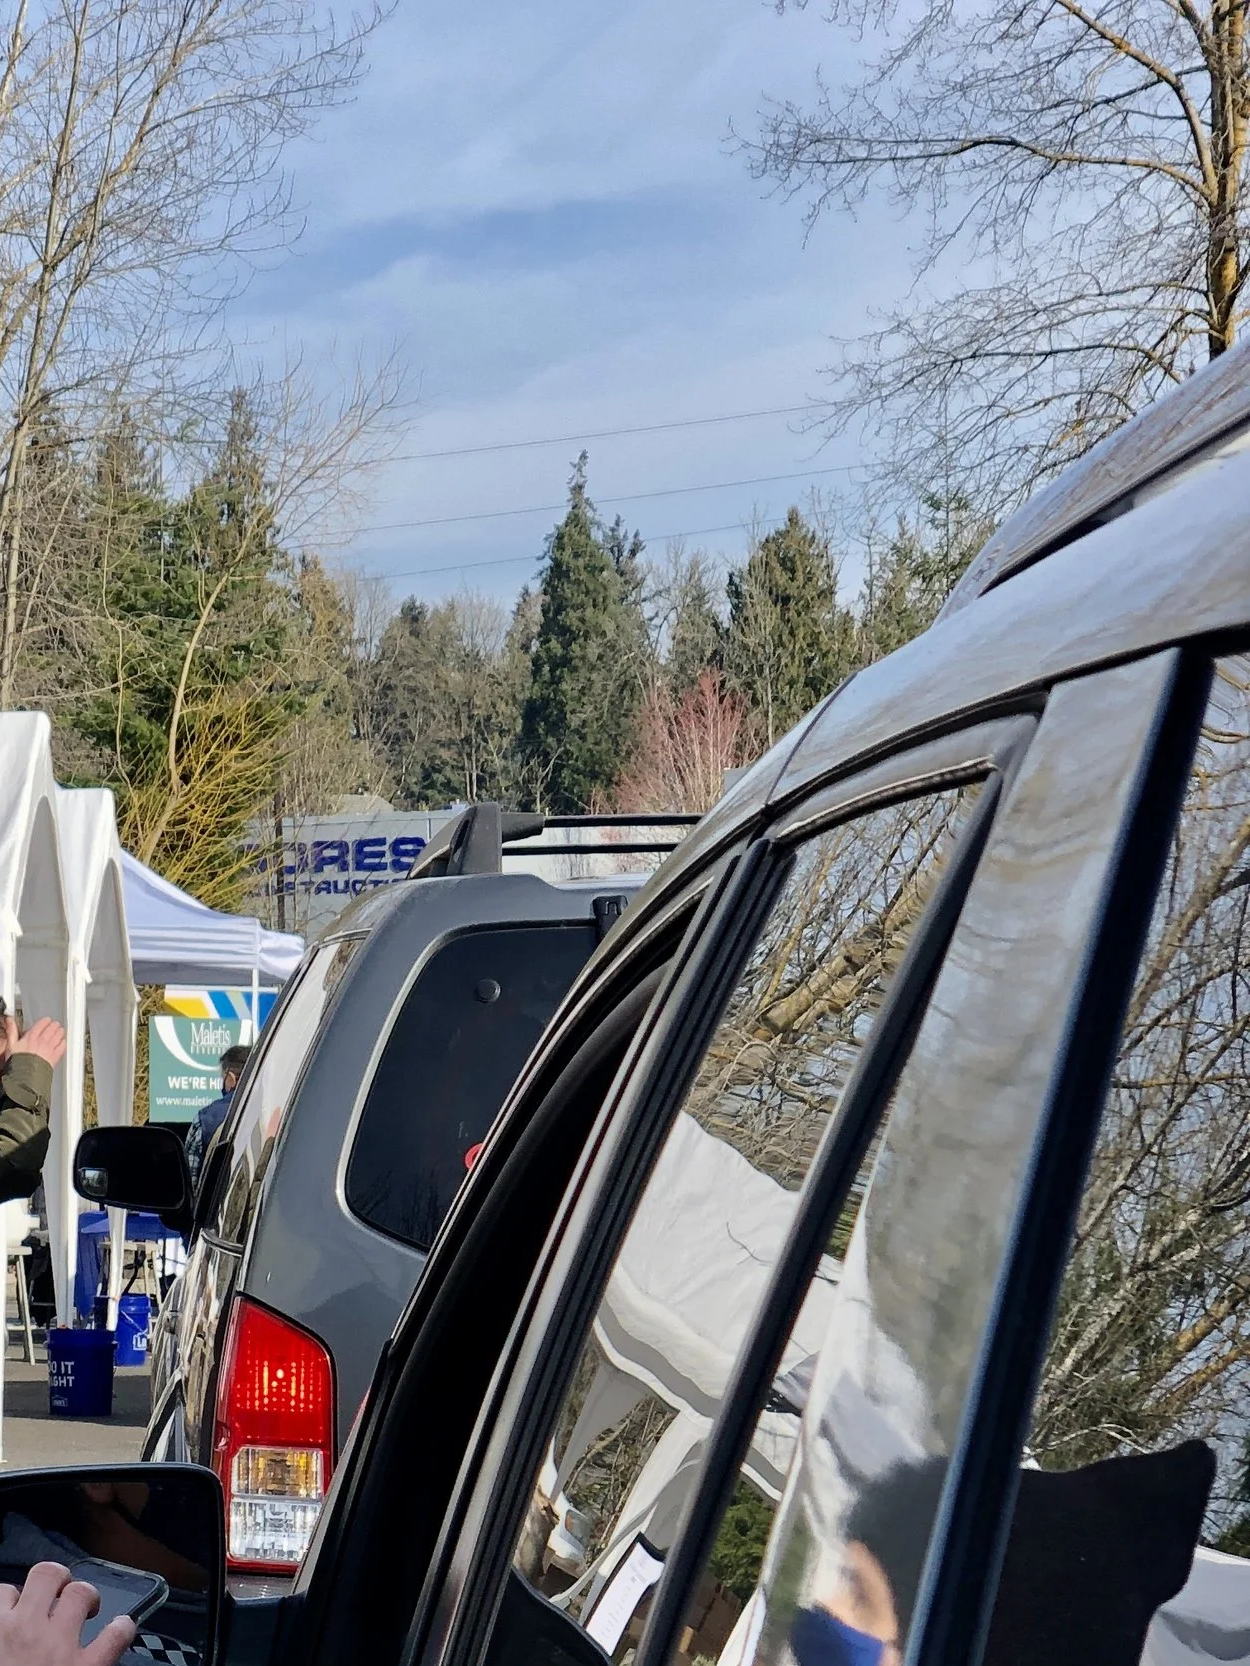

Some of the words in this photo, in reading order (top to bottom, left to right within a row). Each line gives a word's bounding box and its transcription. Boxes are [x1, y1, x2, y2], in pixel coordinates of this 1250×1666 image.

[237, 836, 426, 875] ORES
[190, 1021, 231, 1046] Maletis
[167, 1076, 207, 1090] WE'RE
[209, 1076, 223, 1090] HI
[60, 1360, 75, 1374] IT
[51, 1375, 75, 1387] GHT
